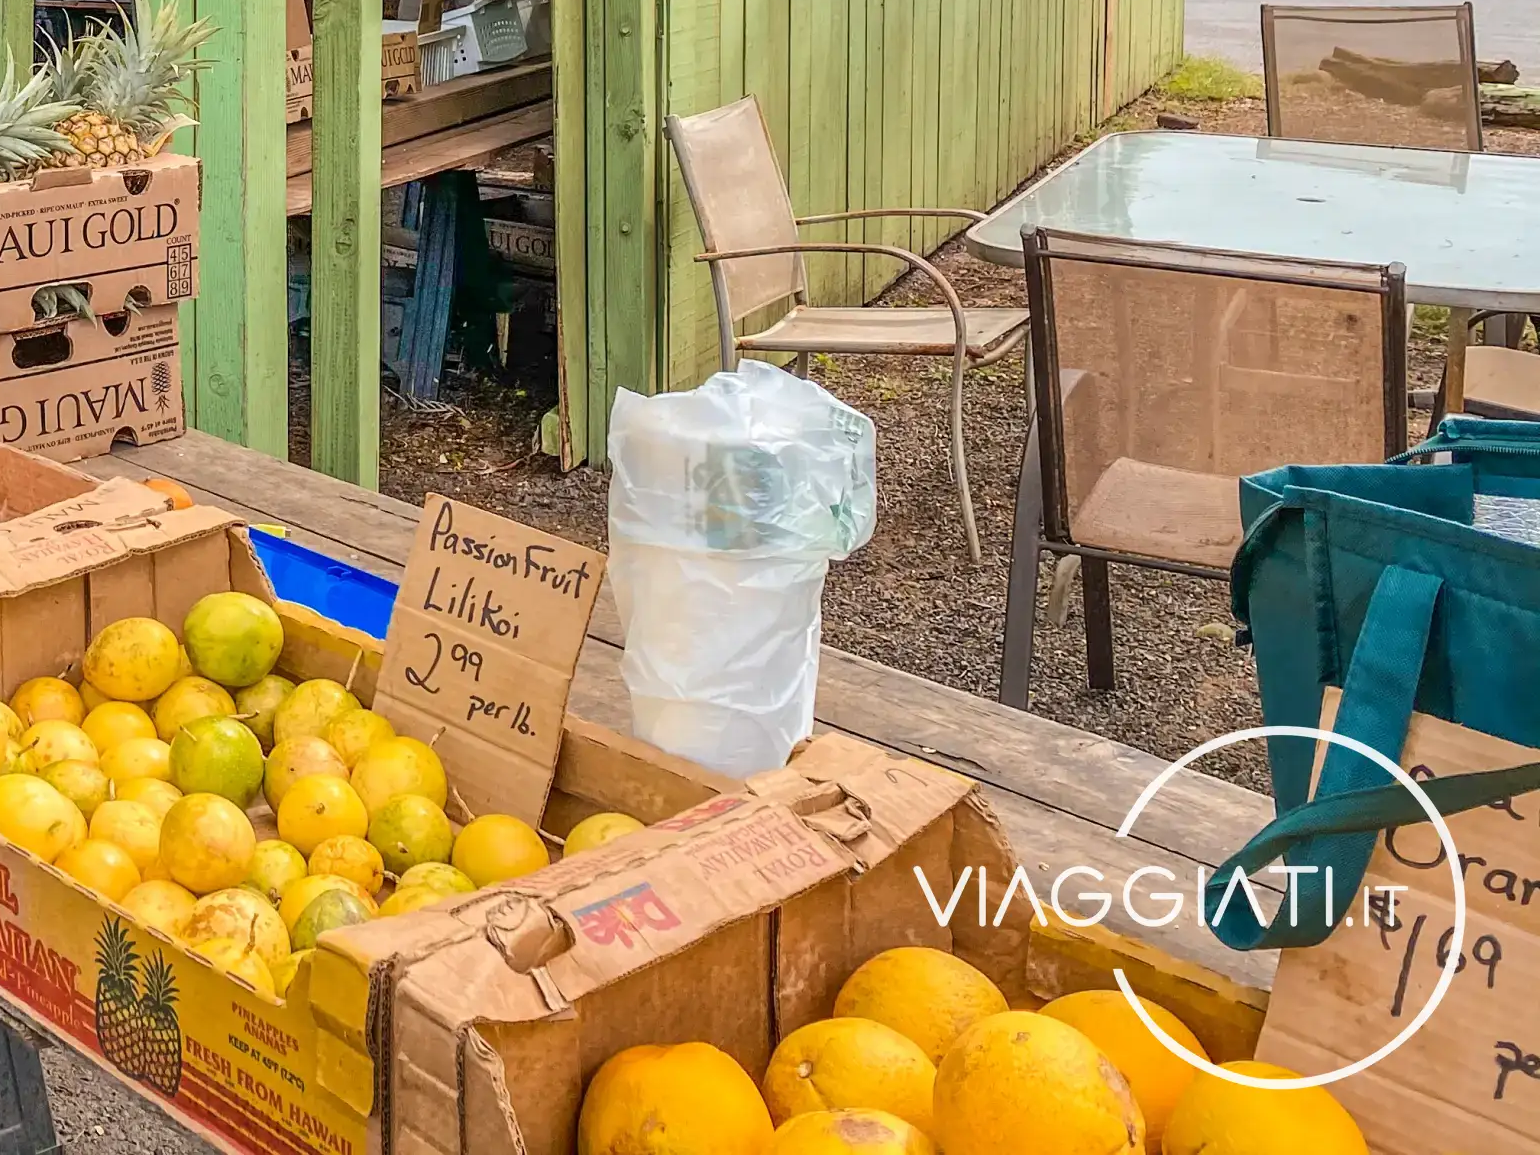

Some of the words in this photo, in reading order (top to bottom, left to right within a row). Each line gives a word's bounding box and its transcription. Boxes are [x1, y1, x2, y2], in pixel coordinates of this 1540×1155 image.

[167, 234, 192, 245] COUNT
[515, 234, 554, 259] GOL
[35, 377, 150, 437] MAUI
[429, 501, 518, 575] Passion
[523, 545, 590, 599] Fruit
[466, 695, 510, 721] per
[752, 841, 828, 886] ROYAL
[578, 889, 683, 951] Dole
[228, 1032, 250, 1054] KEEP
[250, 1045, 261, 1062] AT
[231, 1000, 300, 1053] PINEAPPLES
[243, 1021, 288, 1058] ANANAS
[184, 1034, 233, 1079] FRESH
[236, 1066, 284, 1114] FROM
